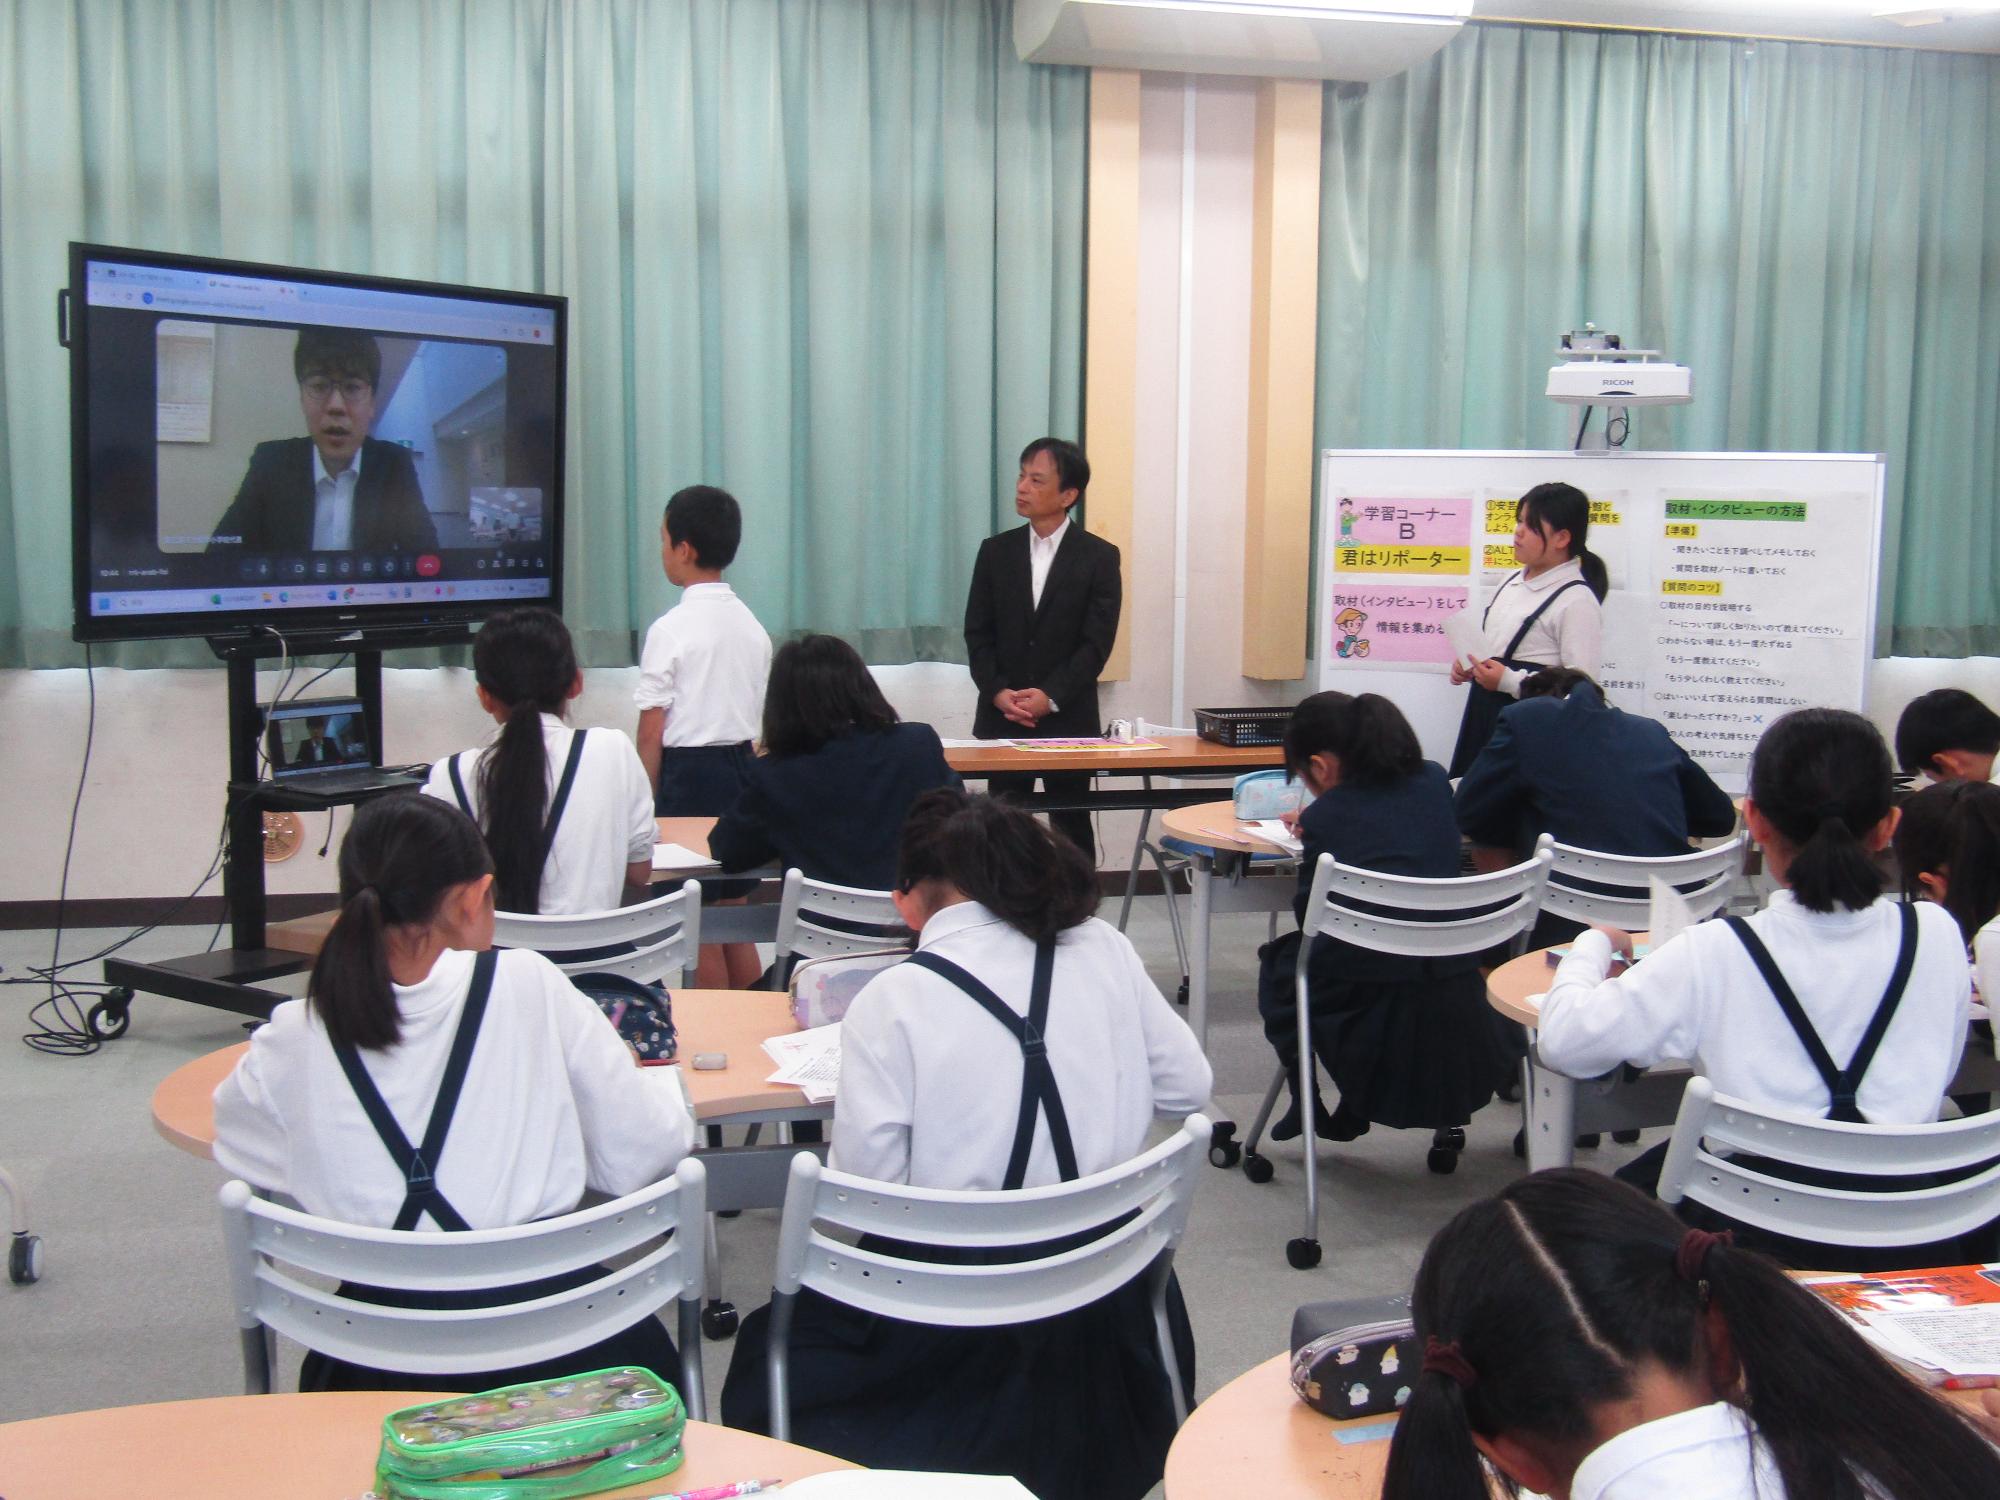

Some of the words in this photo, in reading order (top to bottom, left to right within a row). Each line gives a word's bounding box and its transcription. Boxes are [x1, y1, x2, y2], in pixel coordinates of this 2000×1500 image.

[1364, 506, 1456, 521] 学習コーナー
[1665, 503, 1806, 517] 取材・インタビューの方法
[1400, 523, 1416, 539] B
[1342, 549, 1461, 567] 君はリポーター
[1334, 595, 1467, 608] 取材（インタビュー）をして
[1376, 621, 1445, 634] 情報を集める
[1598, 681, 1646, 689] 名前を言う）
